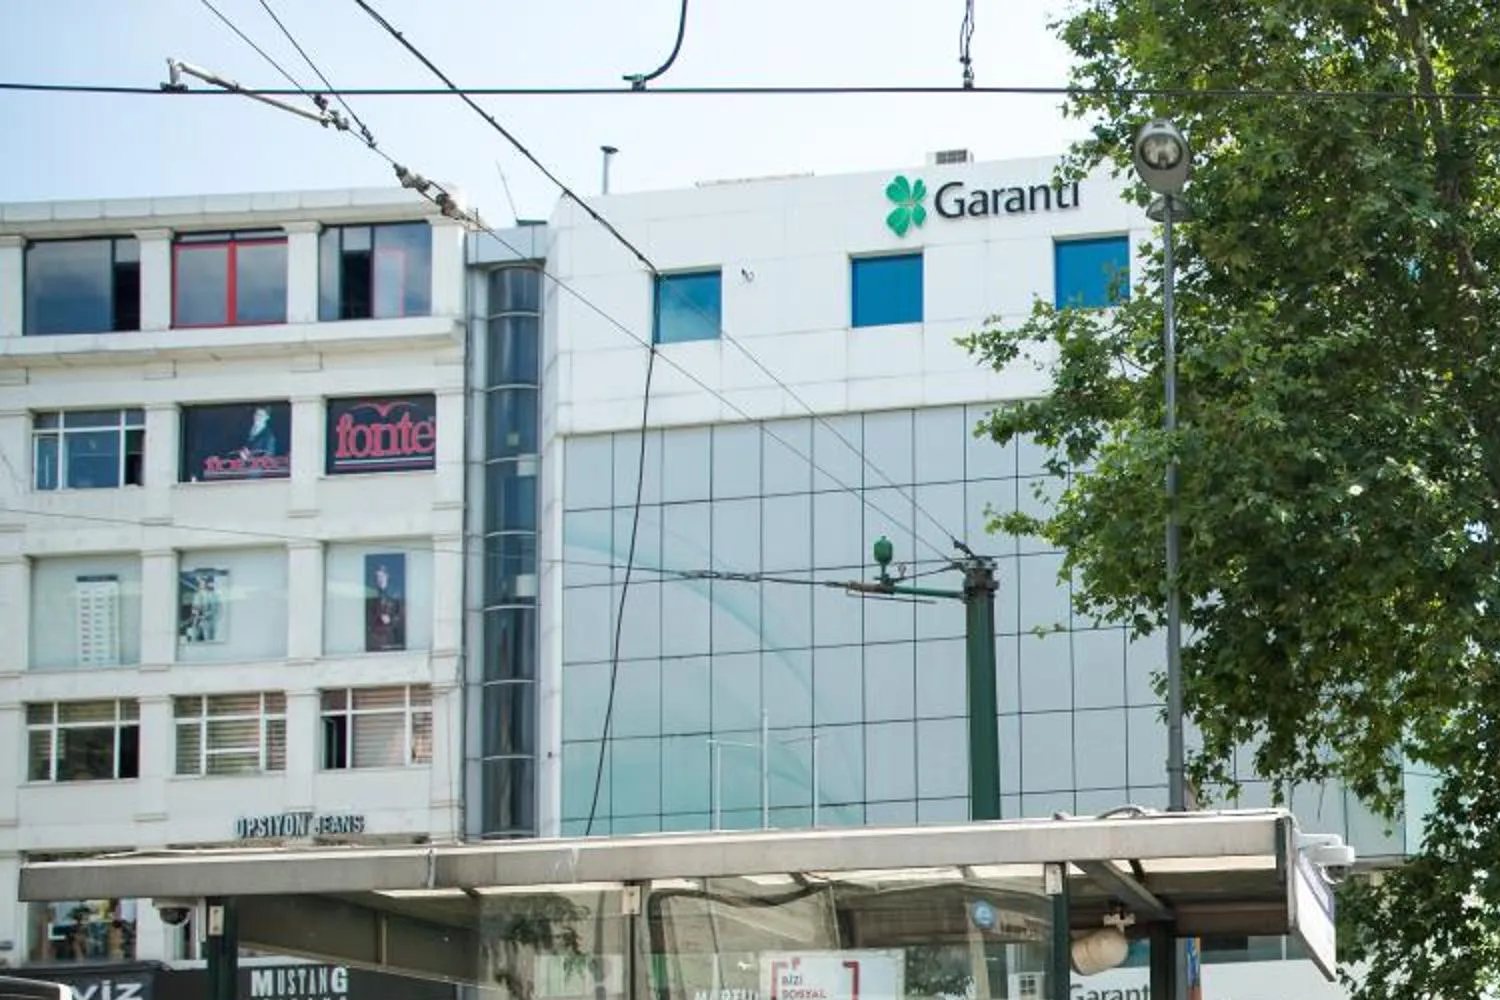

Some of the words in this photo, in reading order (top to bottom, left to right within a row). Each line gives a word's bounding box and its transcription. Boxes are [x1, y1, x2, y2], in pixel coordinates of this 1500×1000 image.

[934, 180, 1080, 219] Garanti
[335, 412, 436, 459] fonte
[251, 966, 348, 998] MUSTANG
